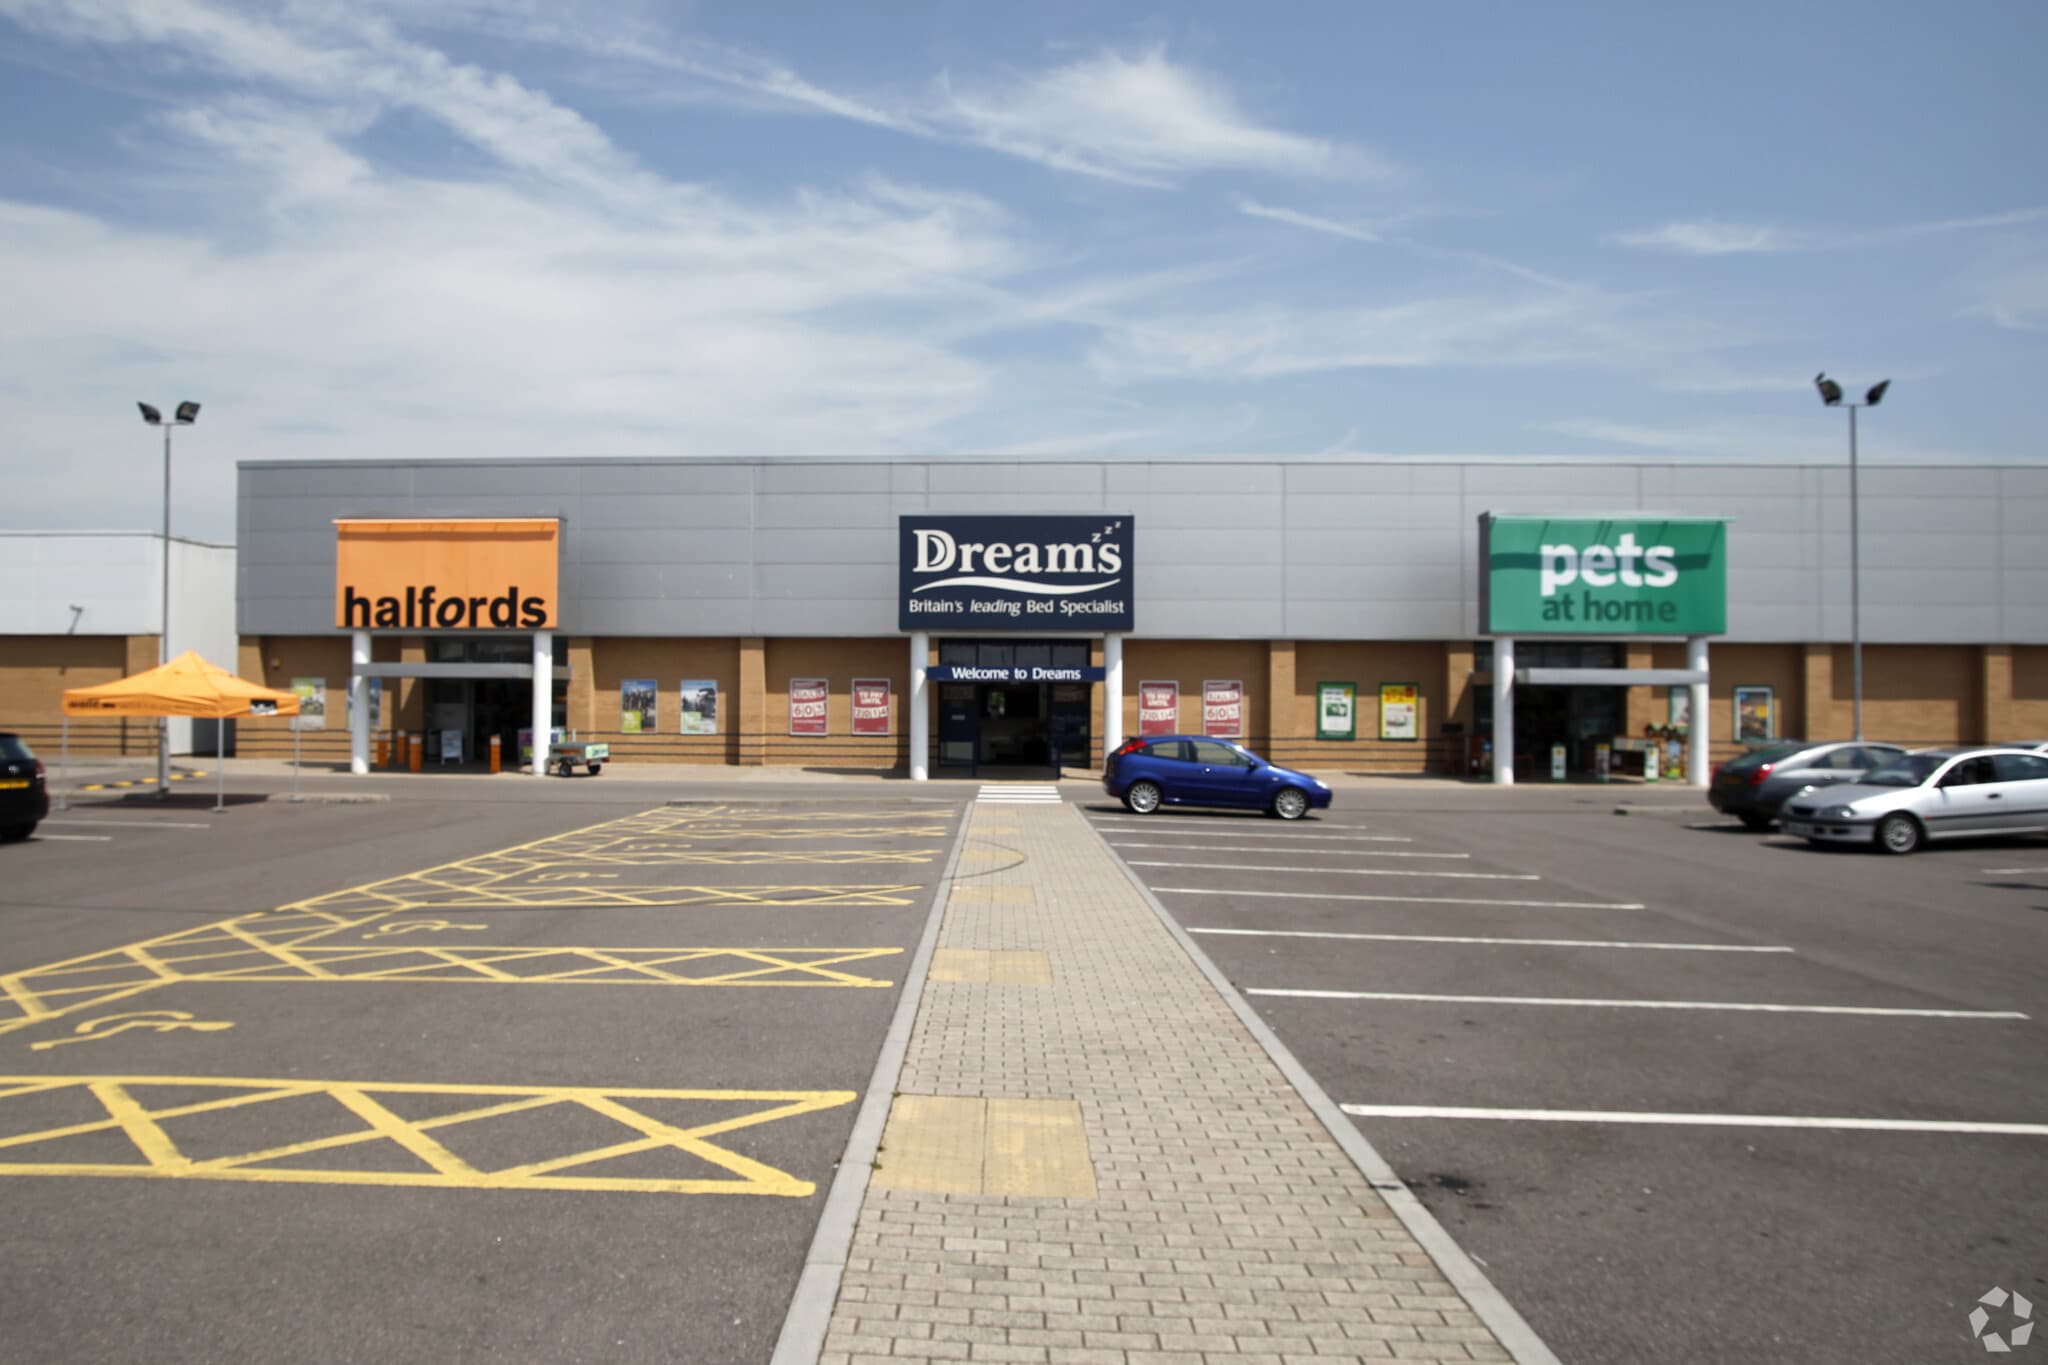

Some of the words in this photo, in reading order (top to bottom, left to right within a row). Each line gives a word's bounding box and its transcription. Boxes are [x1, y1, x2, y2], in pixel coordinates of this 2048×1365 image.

[1540, 533, 1678, 597] pets
[344, 585, 547, 628] halfords
[908, 599, 963, 613] Britain's
[970, 599, 1021, 617] leading
[1026, 599, 1054, 613] Bed
[1059, 599, 1125, 617] Specialist
[1541, 592, 1576, 622] at
[1583, 589, 1678, 622] home
[951, 666, 1009, 680] Welcome
[1014, 667, 1028, 680] to
[1031, 666, 1081, 680] Dreams
